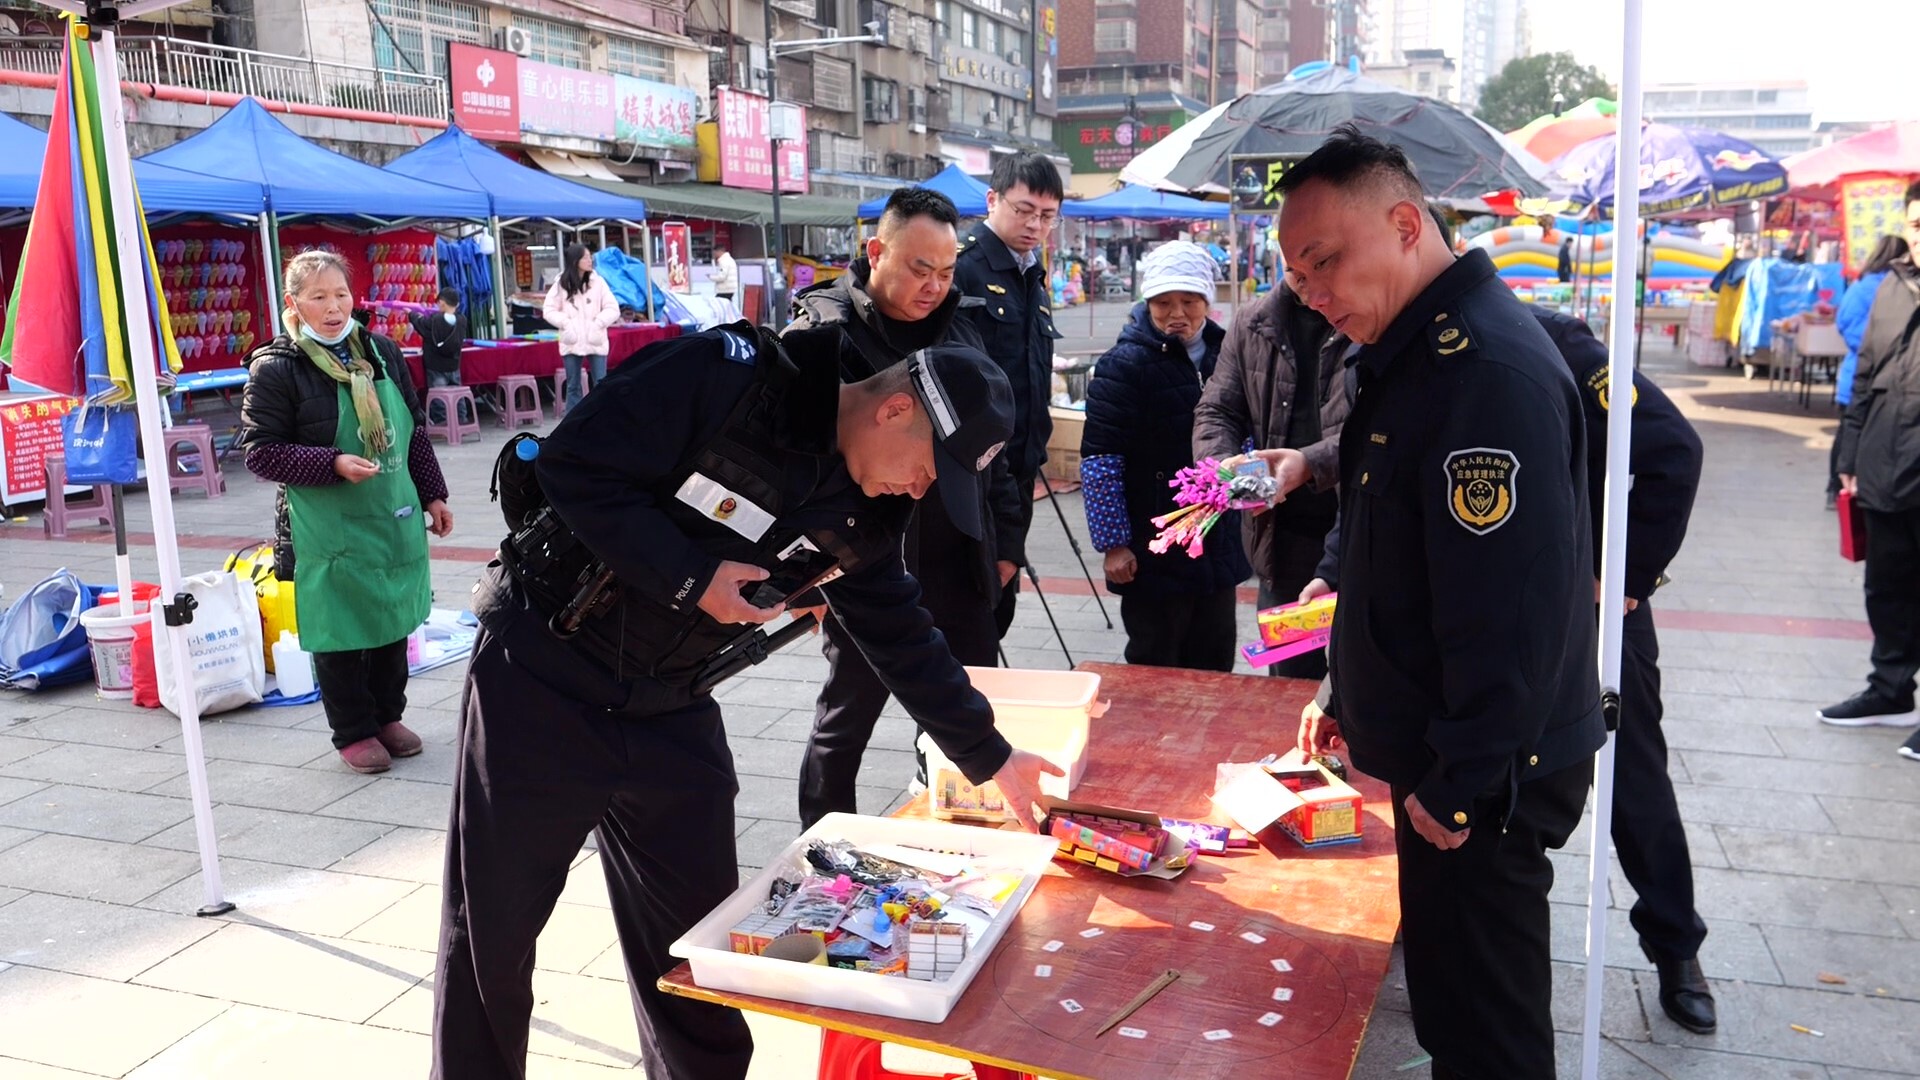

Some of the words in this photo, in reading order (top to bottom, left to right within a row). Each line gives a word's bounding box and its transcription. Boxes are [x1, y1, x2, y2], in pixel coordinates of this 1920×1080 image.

[521, 69, 609, 107] 童心俱乐部
[621, 94, 692, 136] 精灵城堡
[1452, 456, 1510, 470] 中华人民共和国
[1456, 470, 1505, 479] 应急管理执法
[675, 577, 696, 601] POLICE
[187, 626, 239, 647] 小懒烘焙
